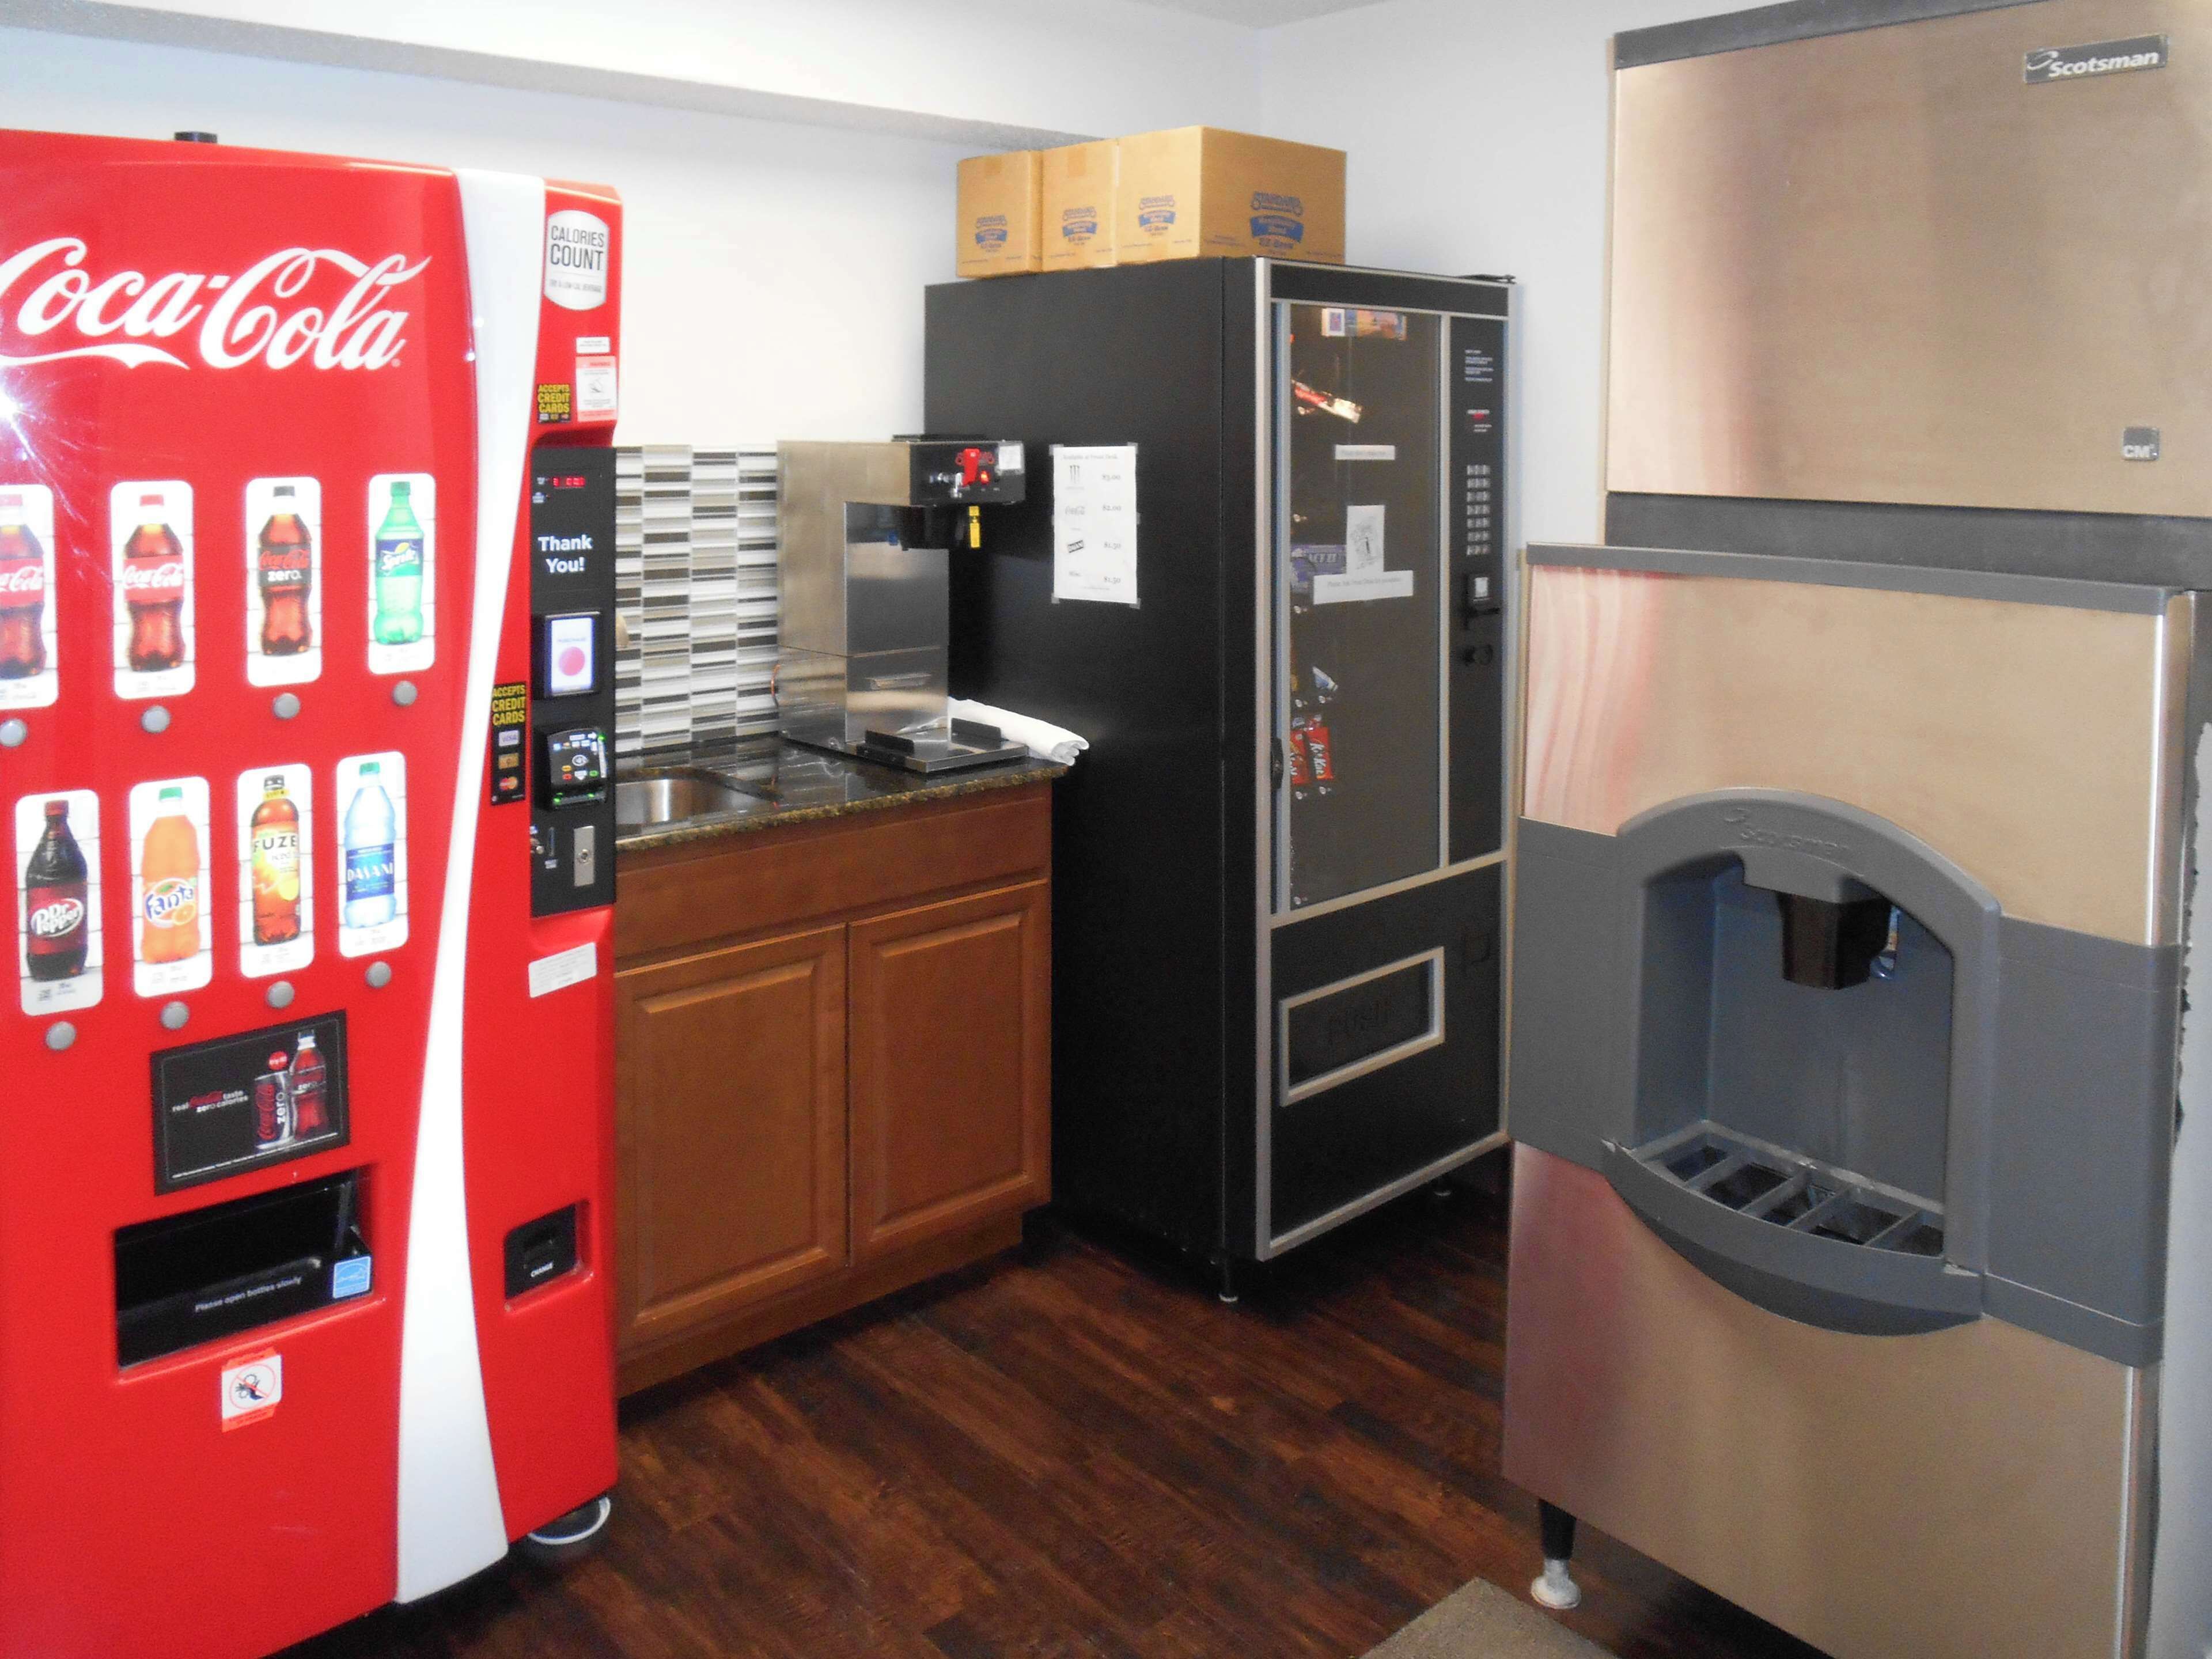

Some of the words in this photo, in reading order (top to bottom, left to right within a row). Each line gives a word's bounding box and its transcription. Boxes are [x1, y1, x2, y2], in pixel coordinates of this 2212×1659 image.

[2048, 51, 2159, 77] Scotsman
[551, 225, 604, 248] CALORIES
[550, 243, 604, 271] COUNT
[0, 236, 432, 370] Coca-Cola
[538, 384, 570, 392] ACCEPTS
[537, 392, 570, 403] CREDIT
[538, 403, 570, 414] CARDS
[537, 534, 593, 551] Thank
[545, 556, 585, 574] You!
[124, 562, 183, 589] Coca-Cola
[268, 570, 302, 582] zero
[493, 685, 525, 697] ACCEPTS
[493, 696, 526, 712] CREDIT
[493, 710, 525, 726] CARDS
[253, 834, 297, 853] FUZE
[48, 903, 70, 918] Dr
[145, 884, 194, 921] Fanta
[36, 908, 80, 935] Pepper
[217, 1094, 248, 1107] calories
[275, 1092, 286, 1124] zero
[224, 1292, 246, 1304] open
[276, 1275, 302, 1289] slowly
